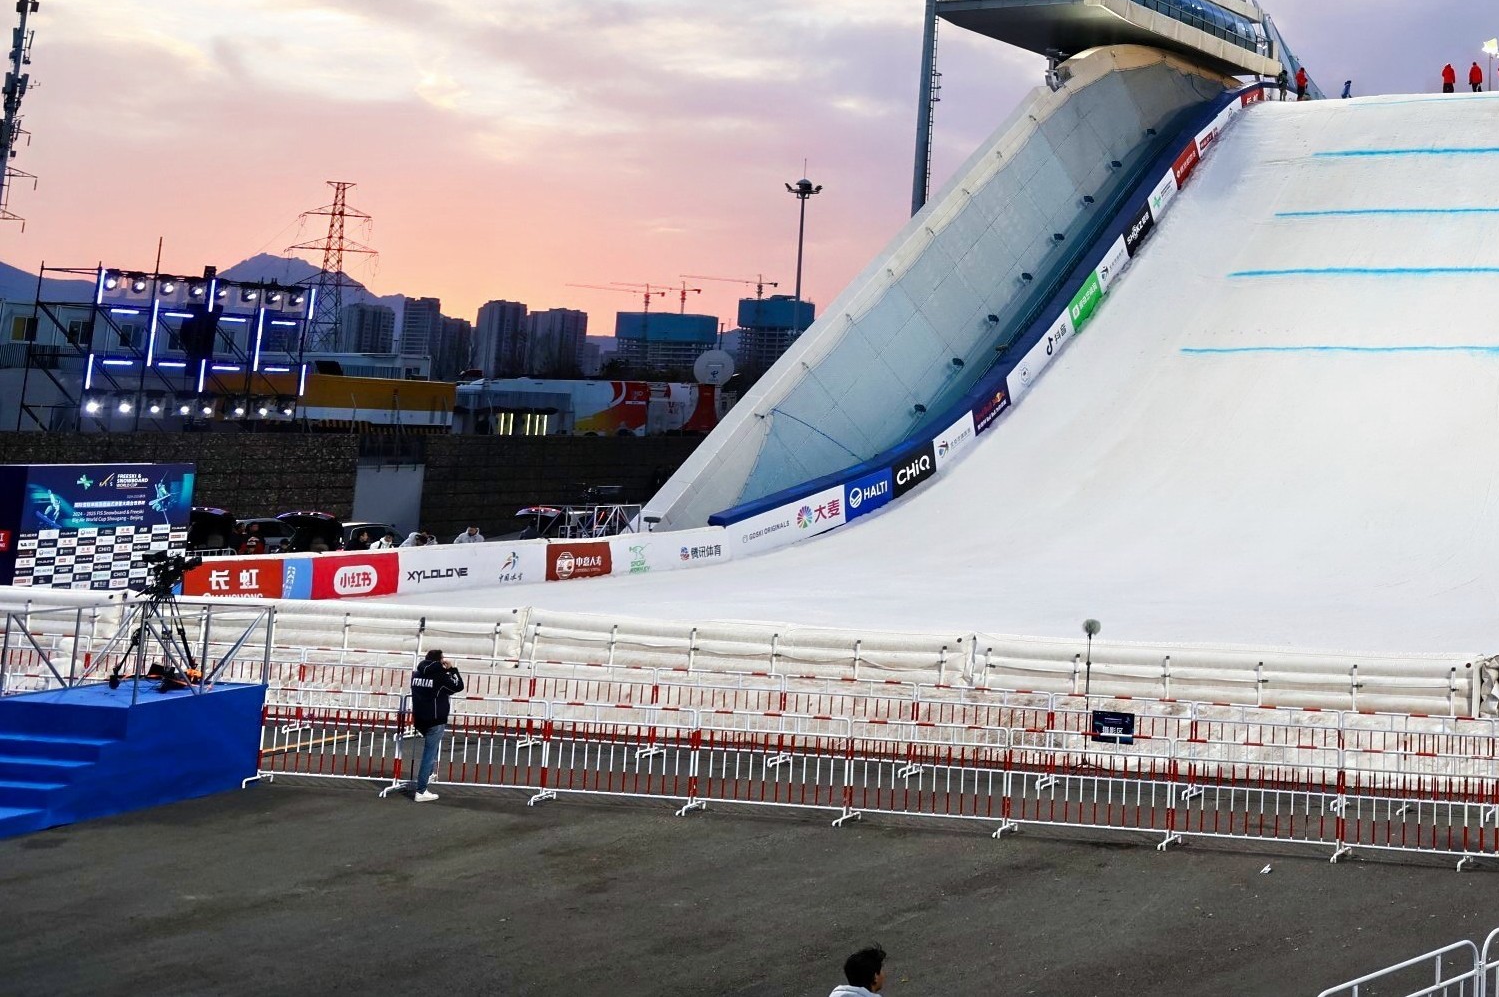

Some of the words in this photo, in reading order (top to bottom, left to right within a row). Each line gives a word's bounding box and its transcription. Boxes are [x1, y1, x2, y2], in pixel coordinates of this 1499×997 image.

[896, 455, 930, 485] CHiQ
[863, 480, 888, 501] HALTI
[814, 499, 840, 523] 大麦
[764, 520, 790, 534] ORIGINALS
[691, 545, 722, 559] 腾讯体育
[209, 569, 259, 590] 长虹
[340, 572, 372, 589] 小红书
[407, 568, 468, 583] XYLOLOVE
[412, 677, 433, 688] ITALIA
